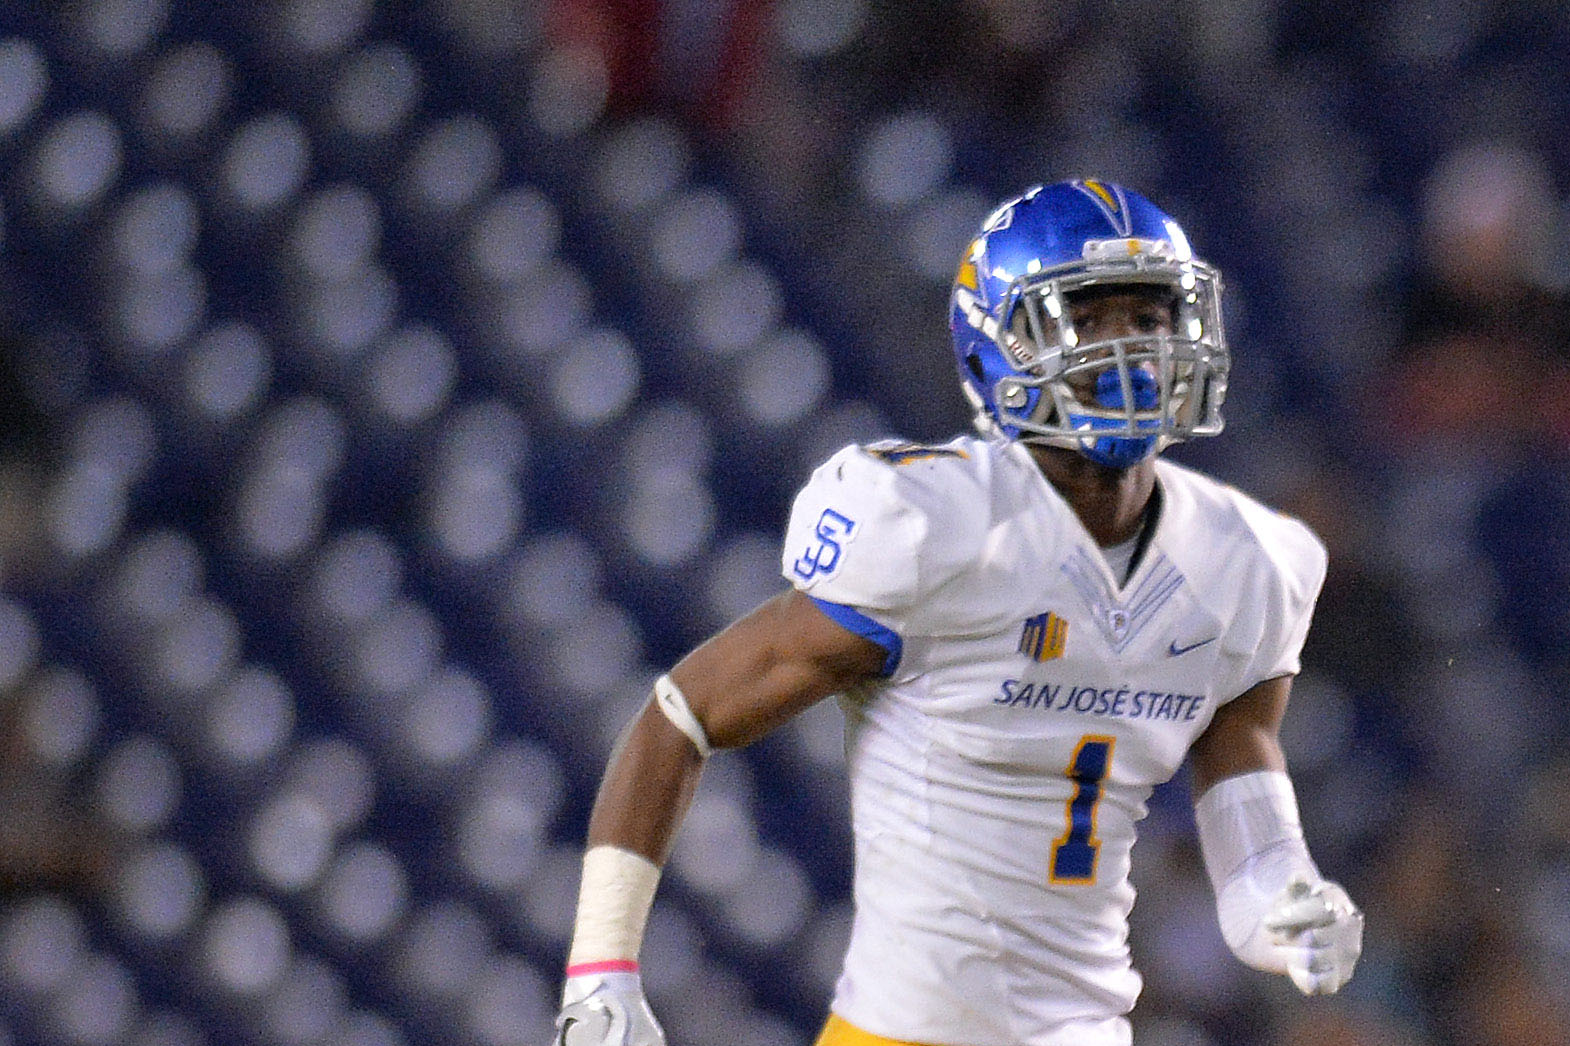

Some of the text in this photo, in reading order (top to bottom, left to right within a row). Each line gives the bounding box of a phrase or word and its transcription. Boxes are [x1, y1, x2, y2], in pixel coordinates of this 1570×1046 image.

[994, 679, 1206, 721] SAN JOSÉ STATE
[1048, 734, 1117, 886] 1
